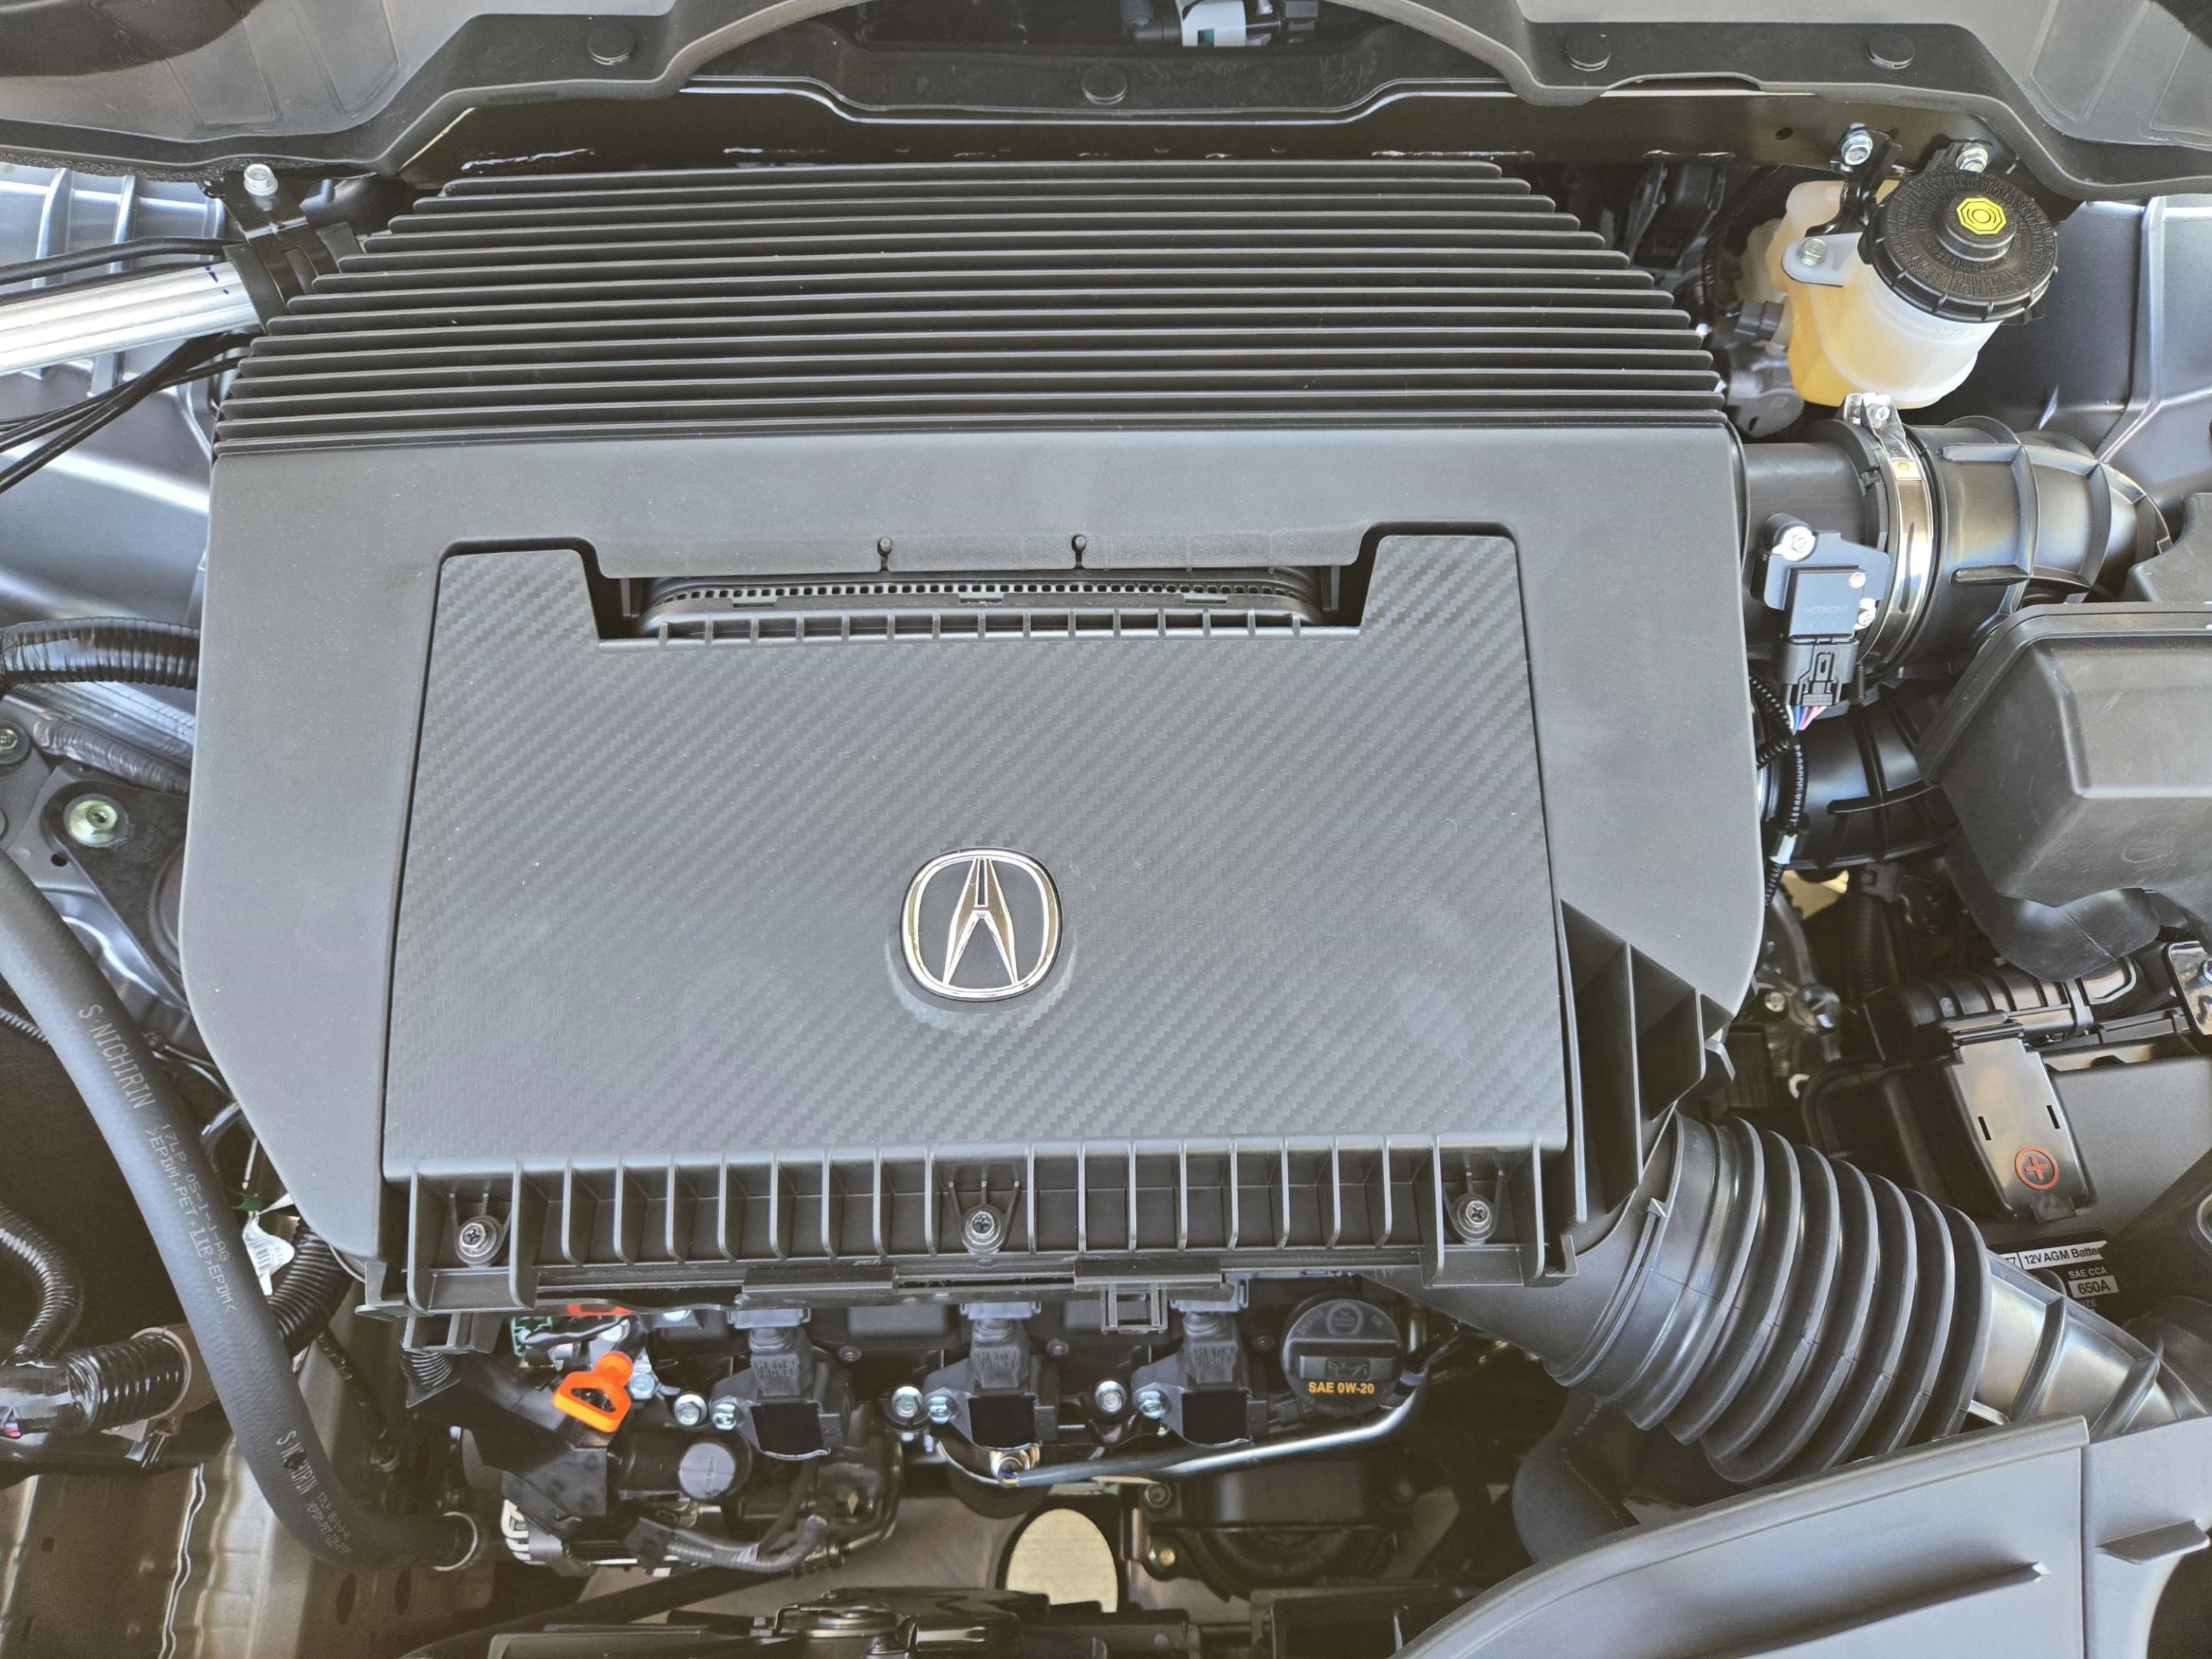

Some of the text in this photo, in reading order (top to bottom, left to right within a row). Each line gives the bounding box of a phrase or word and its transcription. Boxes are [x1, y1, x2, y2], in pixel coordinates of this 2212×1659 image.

[157, 1122, 189, 1164] 17LP
[2023, 1253, 2042, 1265] 12V
[2044, 1250, 2070, 1262] AGM
[2068, 1267, 2108, 1279] SAE CCA
[2078, 1280, 2111, 1295] 650A
[1308, 1381, 1375, 1394] SAE 0W-20
